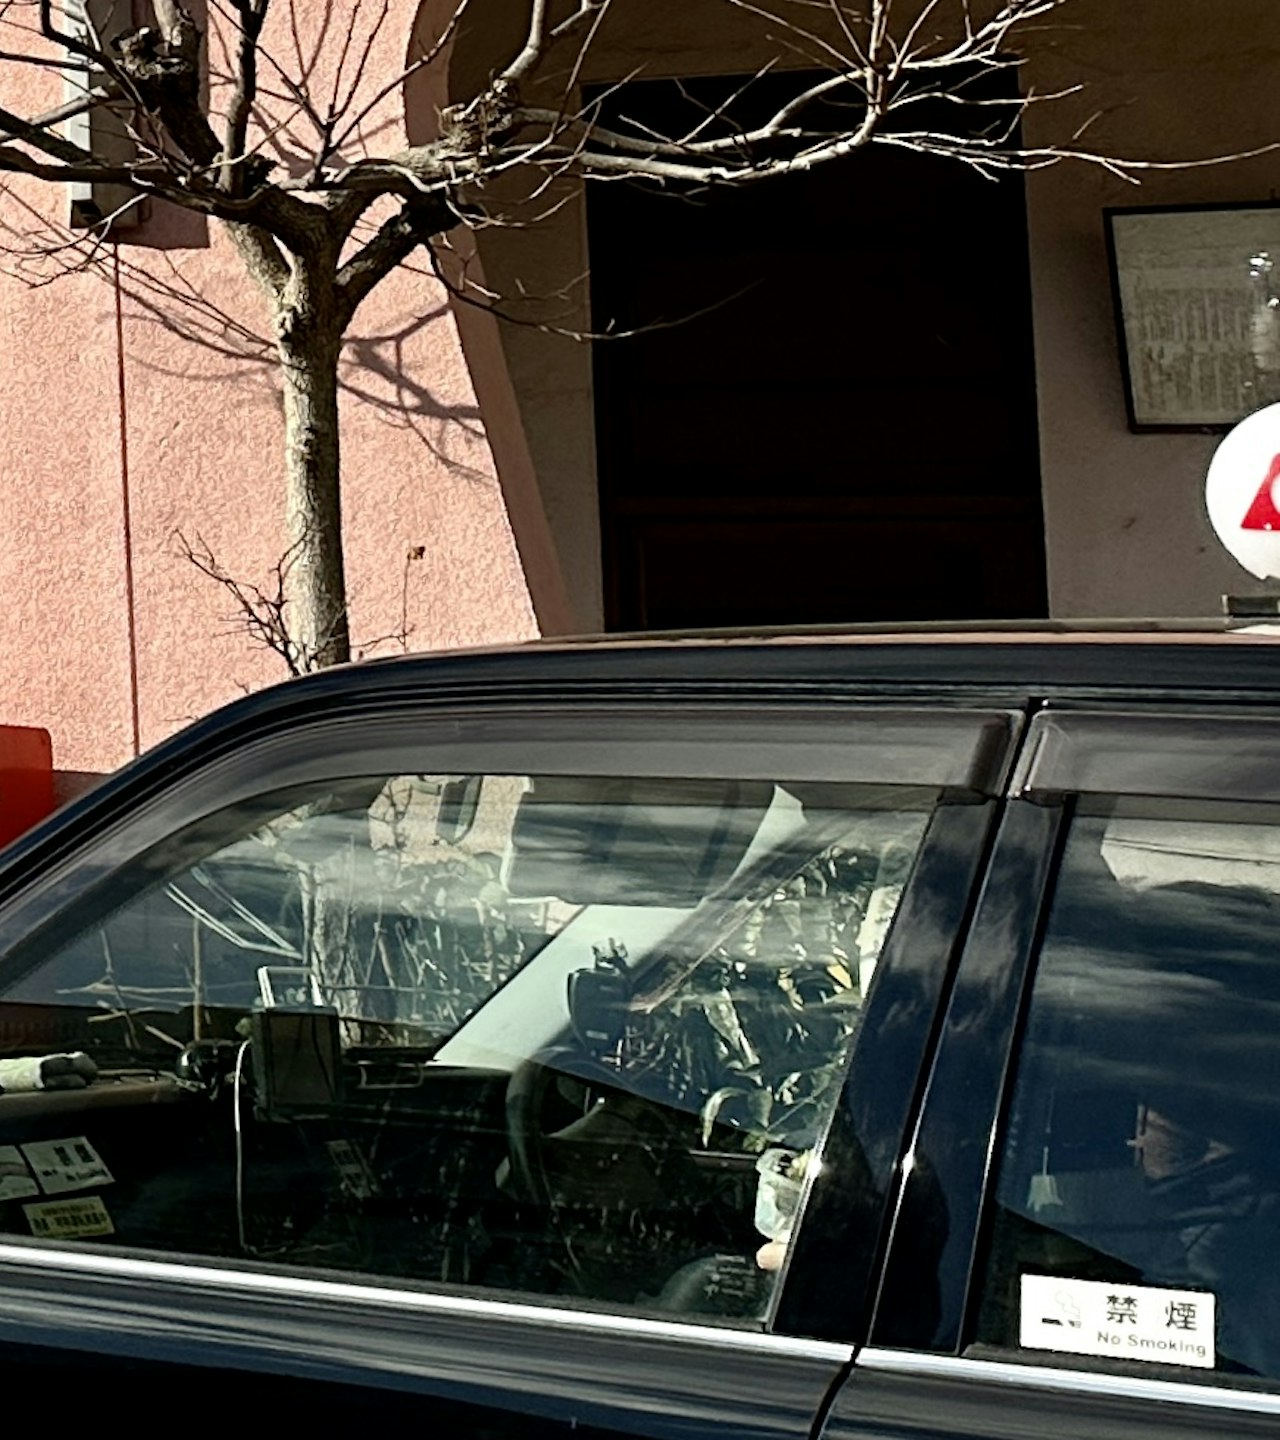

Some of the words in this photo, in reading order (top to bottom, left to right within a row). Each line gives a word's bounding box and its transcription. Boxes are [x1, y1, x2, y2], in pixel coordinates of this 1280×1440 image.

[1106, 1294, 1198, 1331] 禁煙
[1097, 1331, 1121, 1345] No
[1128, 1334, 1207, 1358] Smoking
